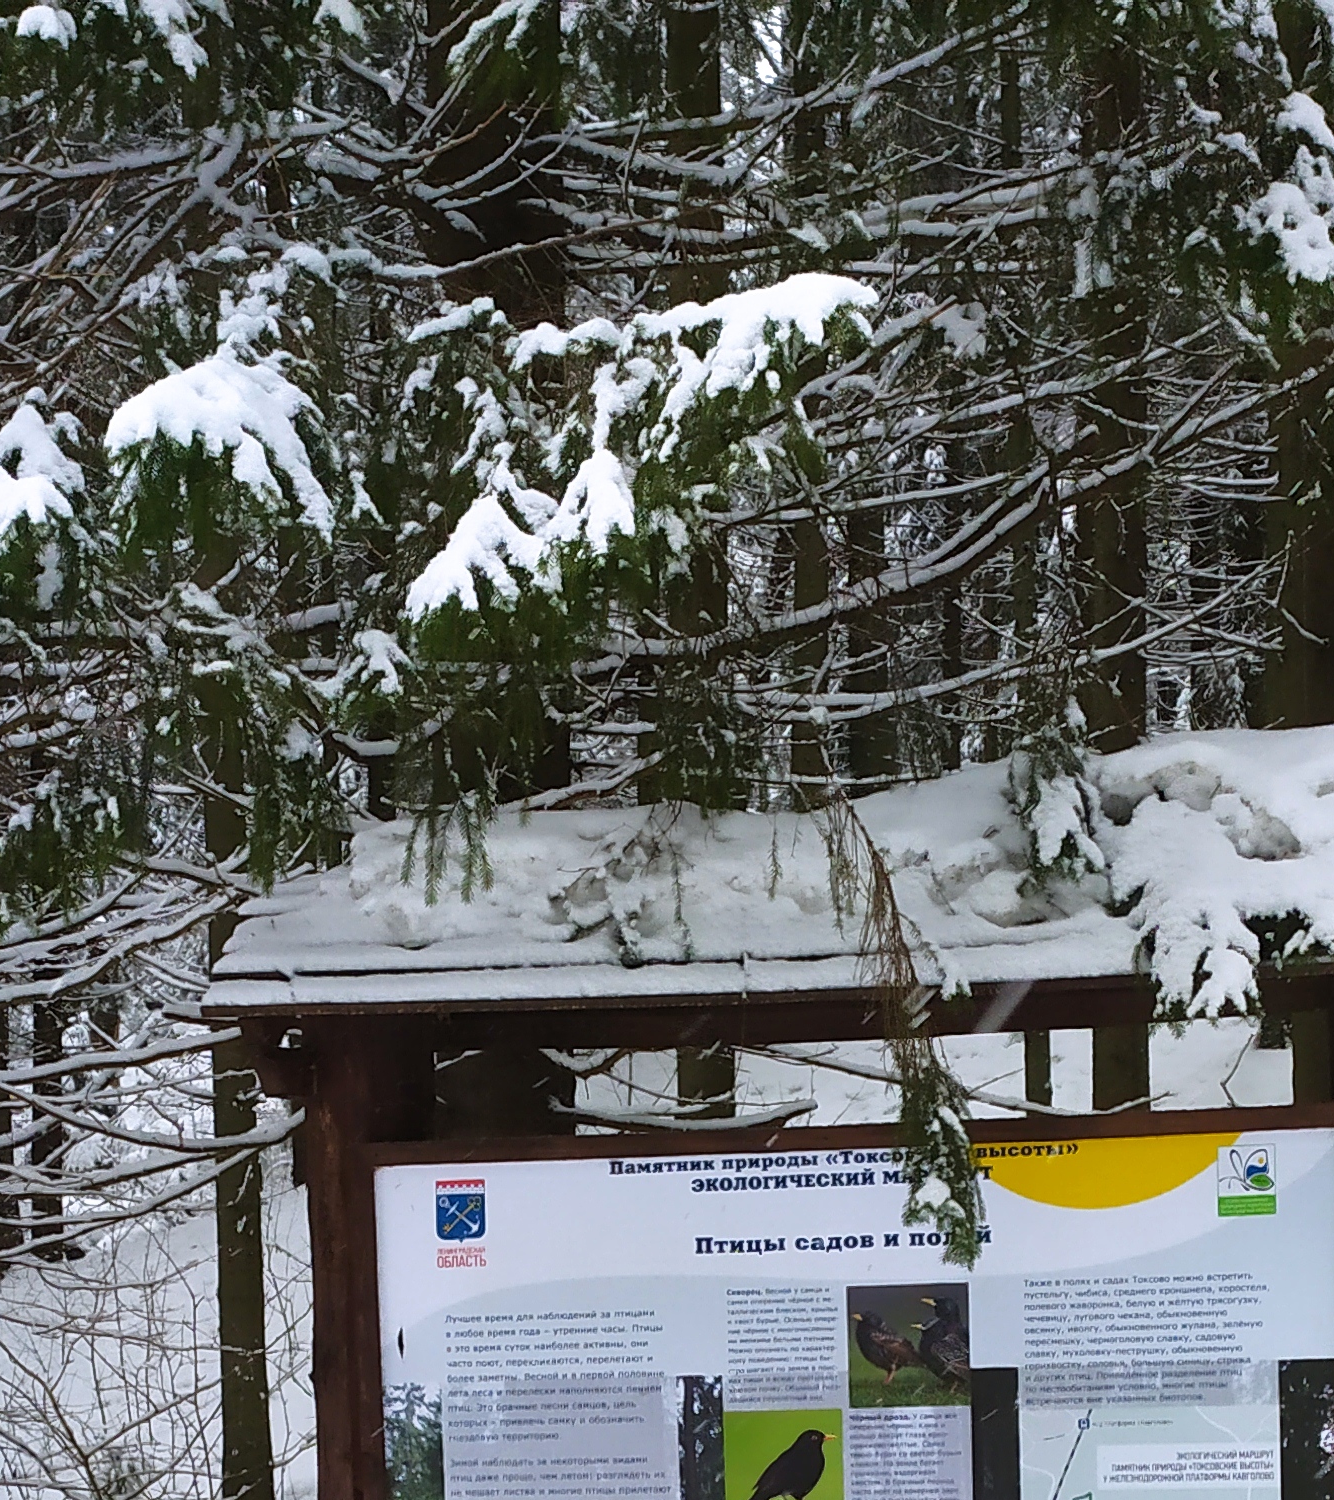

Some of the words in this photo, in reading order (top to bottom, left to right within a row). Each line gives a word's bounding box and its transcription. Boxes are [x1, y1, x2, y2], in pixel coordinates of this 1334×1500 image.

[608, 1159, 715, 1175] Памятник
[721, 1154, 818, 1173] природы
[826, 1148, 961, 1166] «Токсо
[976, 1143, 1079, 1158] высоты»
[691, 1172, 875, 1191] ЭКОЛОГИЧЕСКИЙ
[694, 1235, 785, 1253] Птицы
[794, 1235, 874, 1252] садов
[883, 1233, 899, 1247] и
[909, 1225, 992, 1247] полй
